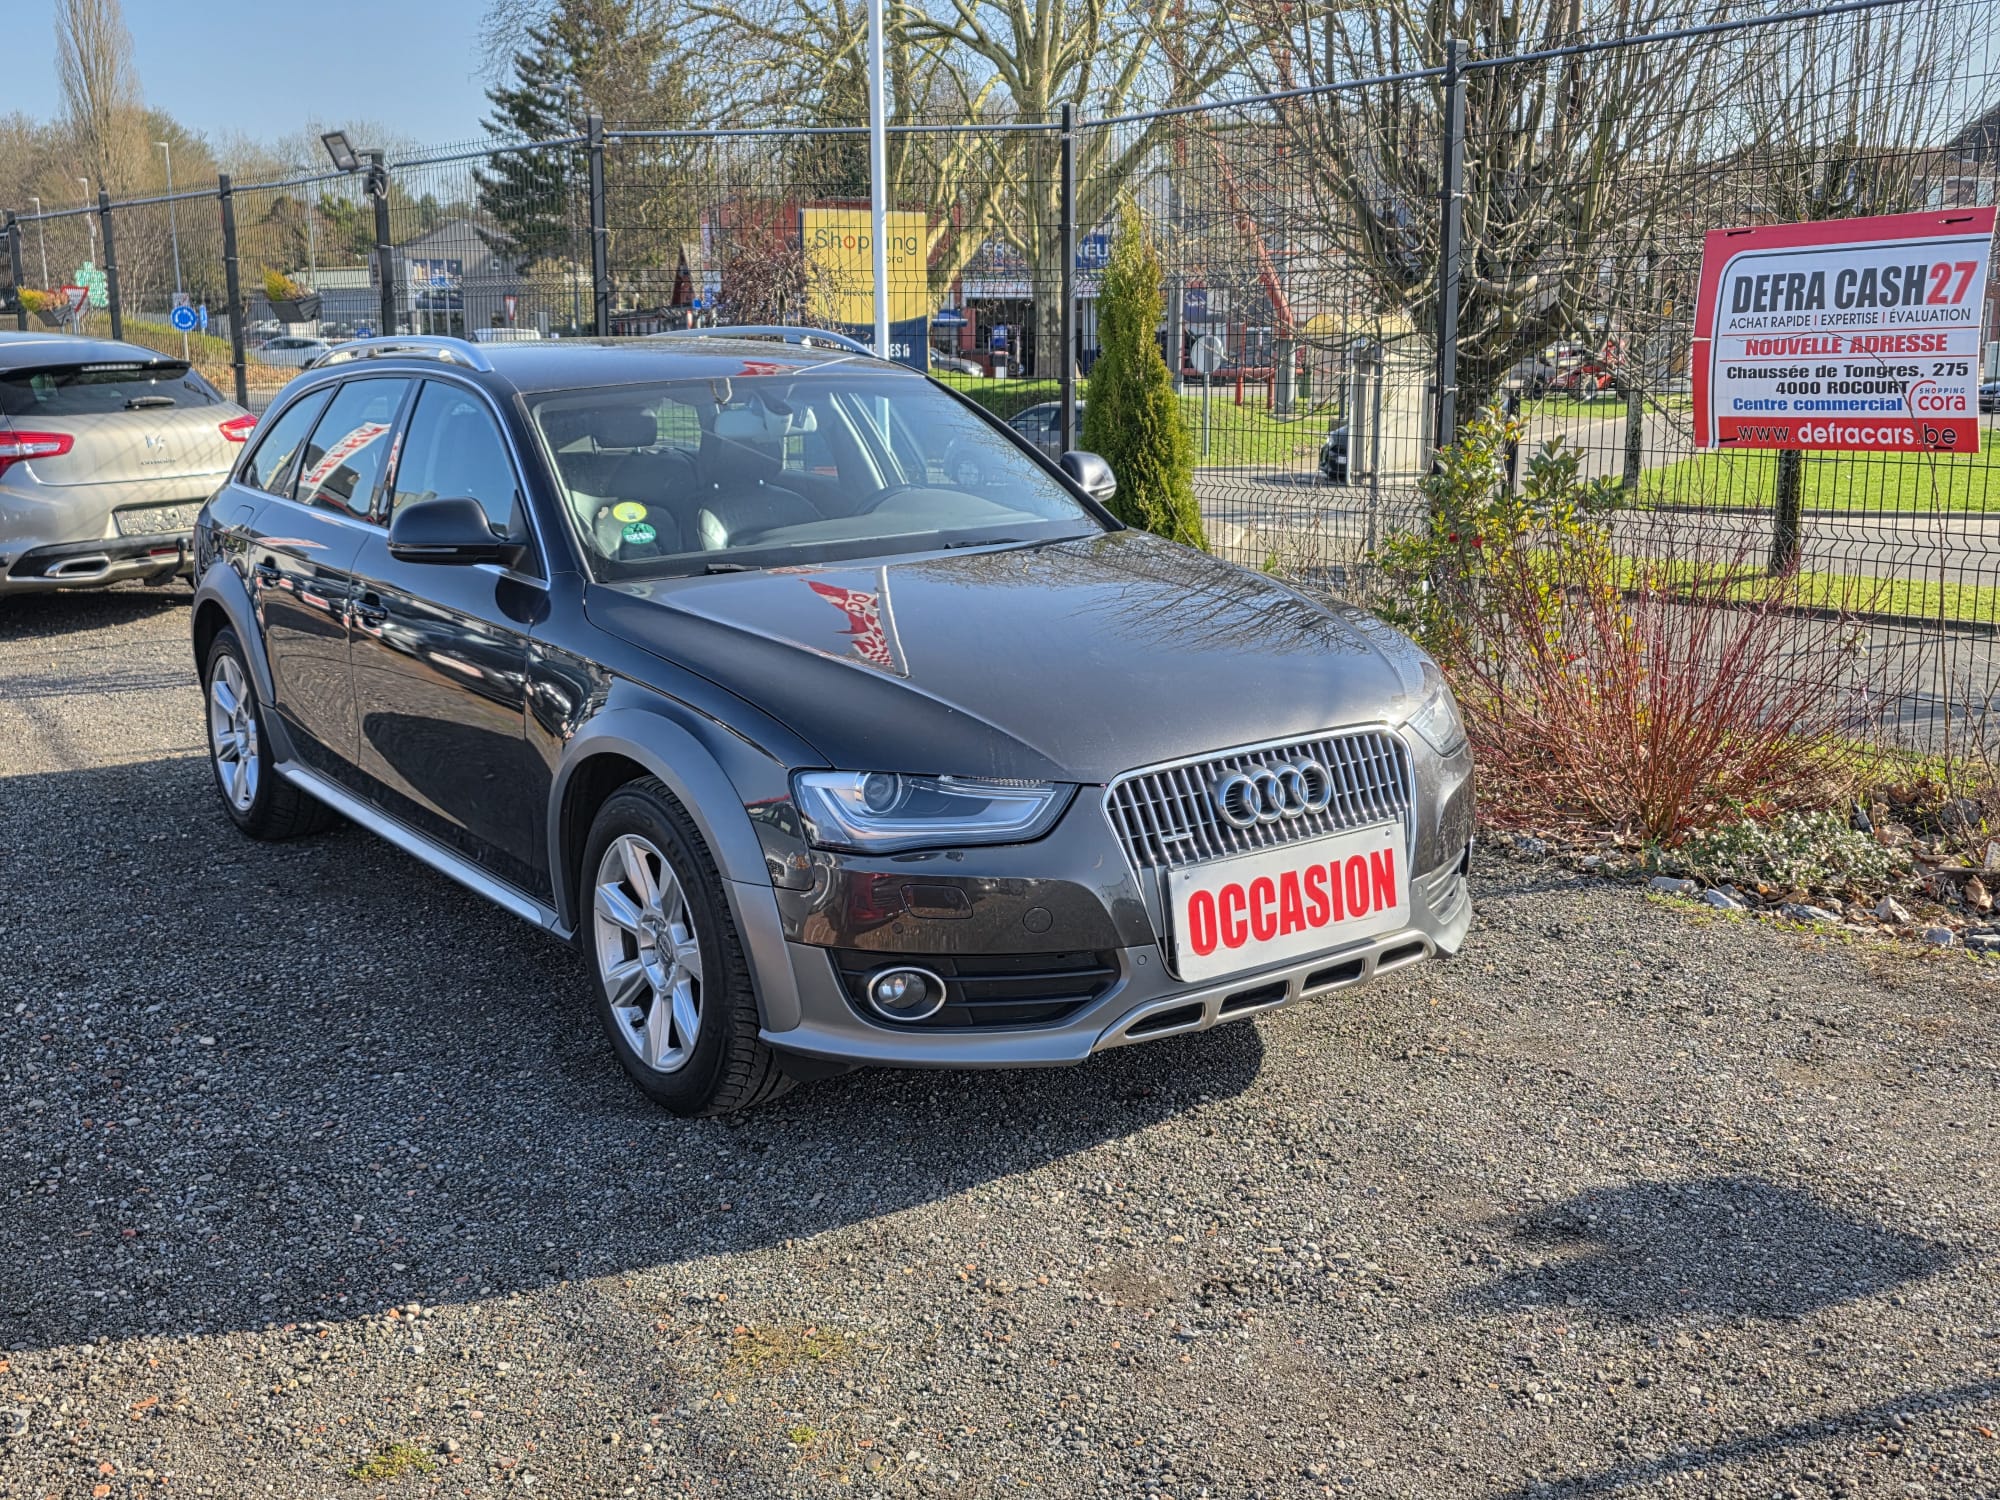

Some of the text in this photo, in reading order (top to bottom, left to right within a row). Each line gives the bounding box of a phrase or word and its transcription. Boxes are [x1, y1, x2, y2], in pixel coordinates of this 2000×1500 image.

[1731, 270, 1826, 314] DEFRA
[1729, 308, 1971, 330] ACHAT RAPIDE EXPERTISE ÉVALUATION
[1745, 333, 1948, 356] NOUVELLE ADRESSE
[1726, 362, 1969, 380] Chaussée de Tongres, 275
[1775, 380, 1910, 395] 4000 ROCOURT
[1919, 387, 1966, 395] SHOPPING
[1733, 397, 1903, 411] Centre commercial
[1917, 394, 1967, 412] cora
[1736, 422, 1958, 446] www.defracars.be
[1187, 848, 1398, 957] OCCASION
